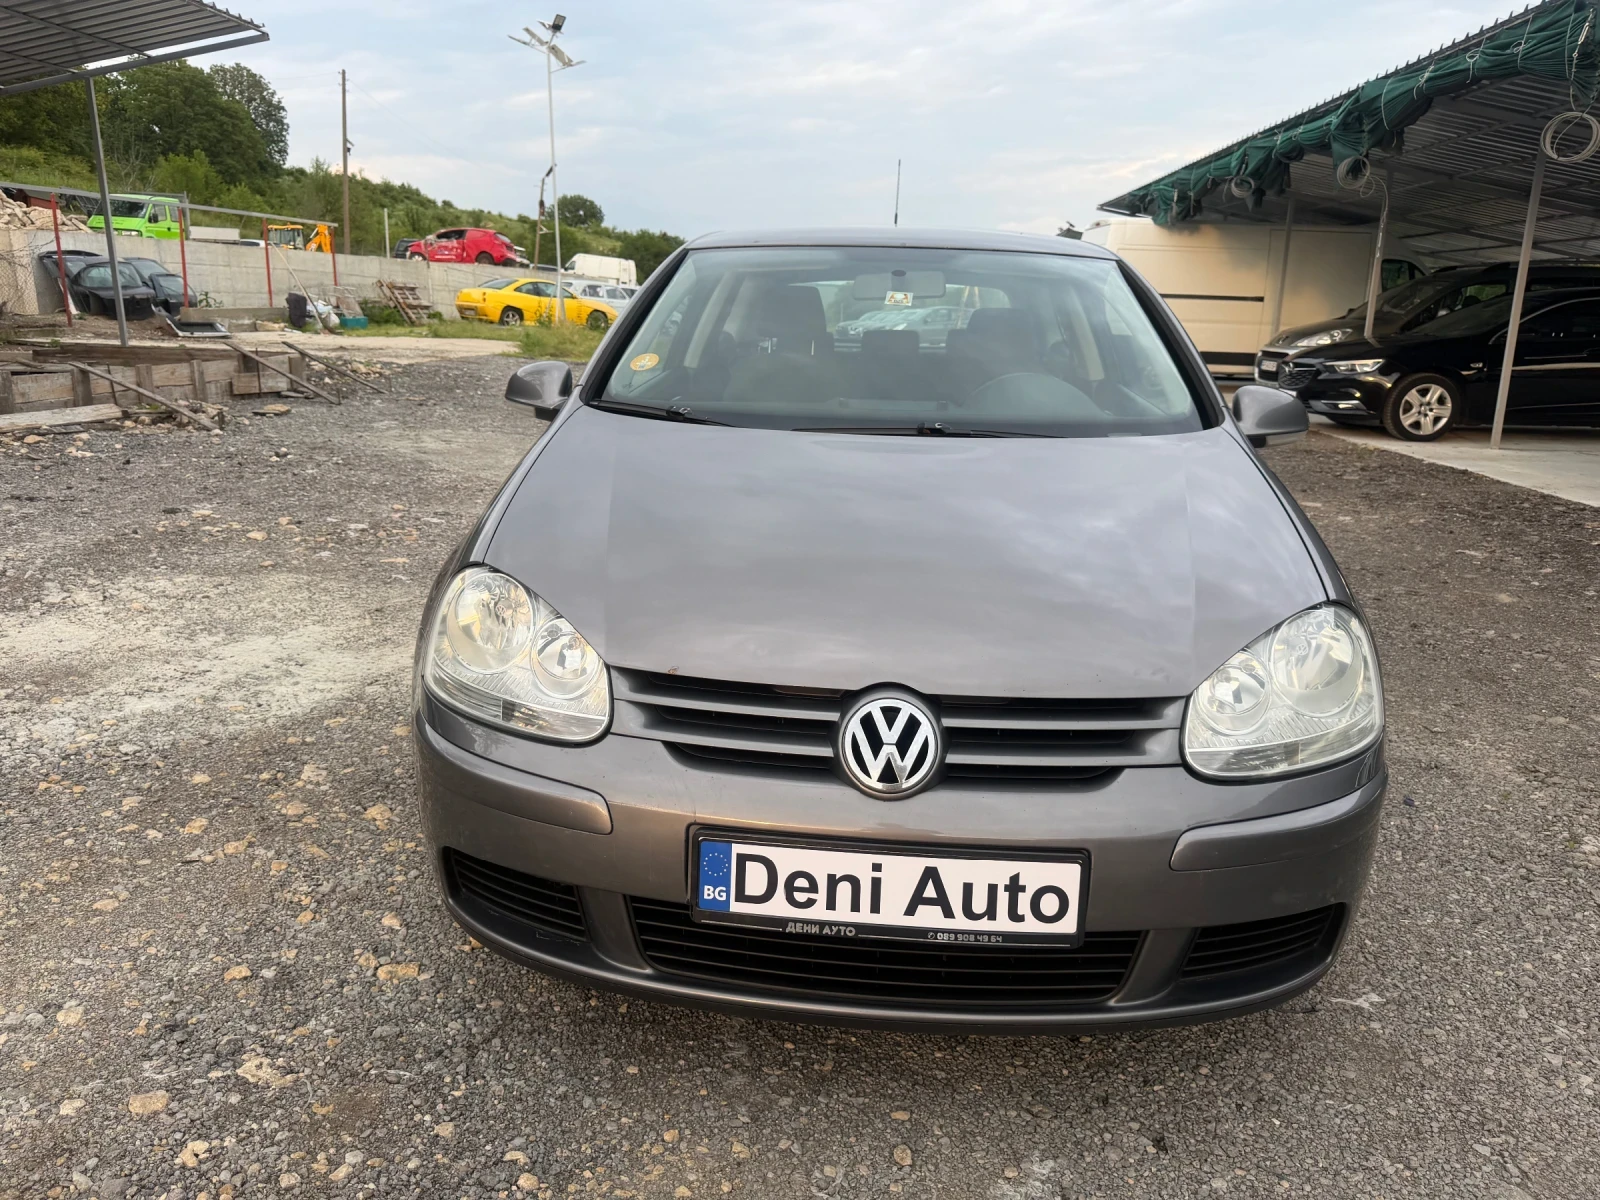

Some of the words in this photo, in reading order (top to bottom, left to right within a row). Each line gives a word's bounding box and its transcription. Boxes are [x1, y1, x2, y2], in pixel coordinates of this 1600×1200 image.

[848, 700, 934, 790] VW
[703, 885, 727, 901] BG
[735, 853, 882, 915] Deni
[904, 866, 1070, 924] Auto
[785, 921, 820, 934] ДЕНИ
[822, 924, 856, 937] АУТО
[936, 932, 955, 941] 089
[957, 933, 975, 942] 908
[977, 934, 989, 943] 49
[990, 935, 1003, 943] 64
